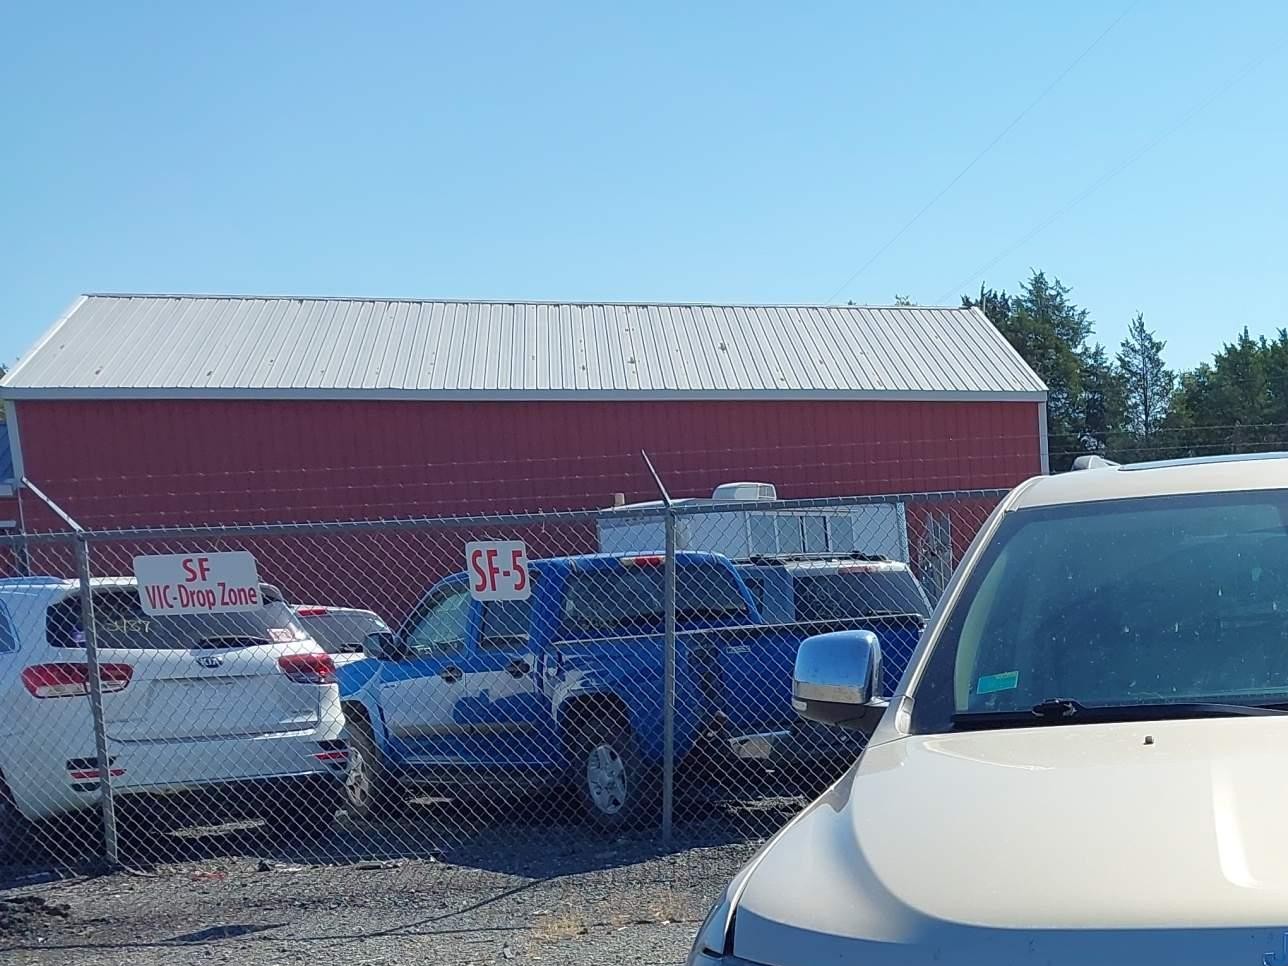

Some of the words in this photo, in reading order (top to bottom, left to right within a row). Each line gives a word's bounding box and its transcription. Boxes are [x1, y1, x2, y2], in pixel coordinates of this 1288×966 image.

[182, 557, 211, 583] SF
[471, 549, 526, 592] SF-5
[145, 584, 217, 610] VIC-Drop
[217, 582, 258, 606] Zone
